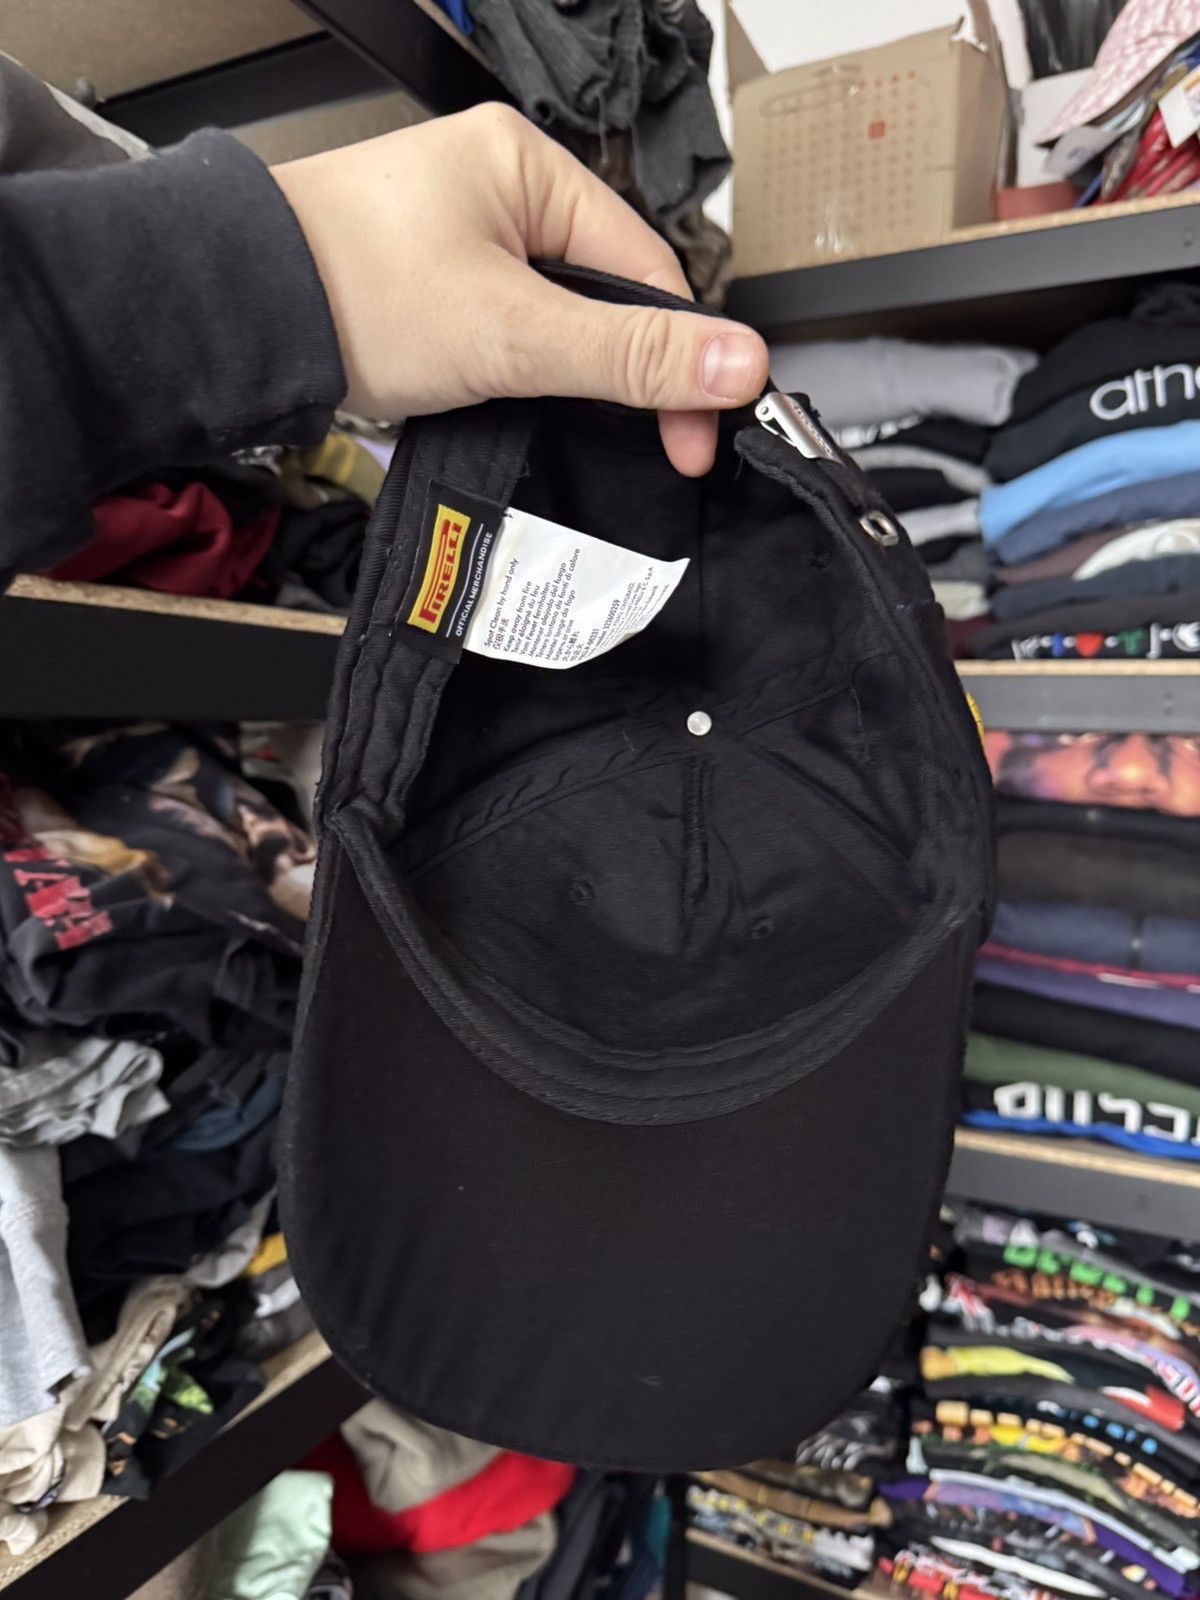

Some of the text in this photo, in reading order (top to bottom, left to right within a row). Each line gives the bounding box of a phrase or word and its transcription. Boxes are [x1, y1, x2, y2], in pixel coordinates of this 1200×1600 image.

[419, 520, 462, 624] PIRELLI
[456, 532, 492, 636] OFFICIAL MERCHANDISE
[484, 558, 519, 647] Spot Clean by hand only
[528, 599, 535, 609] du
[530, 585, 540, 597] feu
[535, 549, 580, 657] Tenere lontano da fonti di calore
[503, 581, 532, 652] Keep away from fire
[511, 638, 522, 653] Tenir
[519, 582, 550, 655] Vom Feuer fernhalten
[528, 563, 566, 657] Mantener alejado del fuego
[545, 638, 558, 660] Manter
[554, 619, 565, 637] longe
[564, 590, 575, 606] fogo
